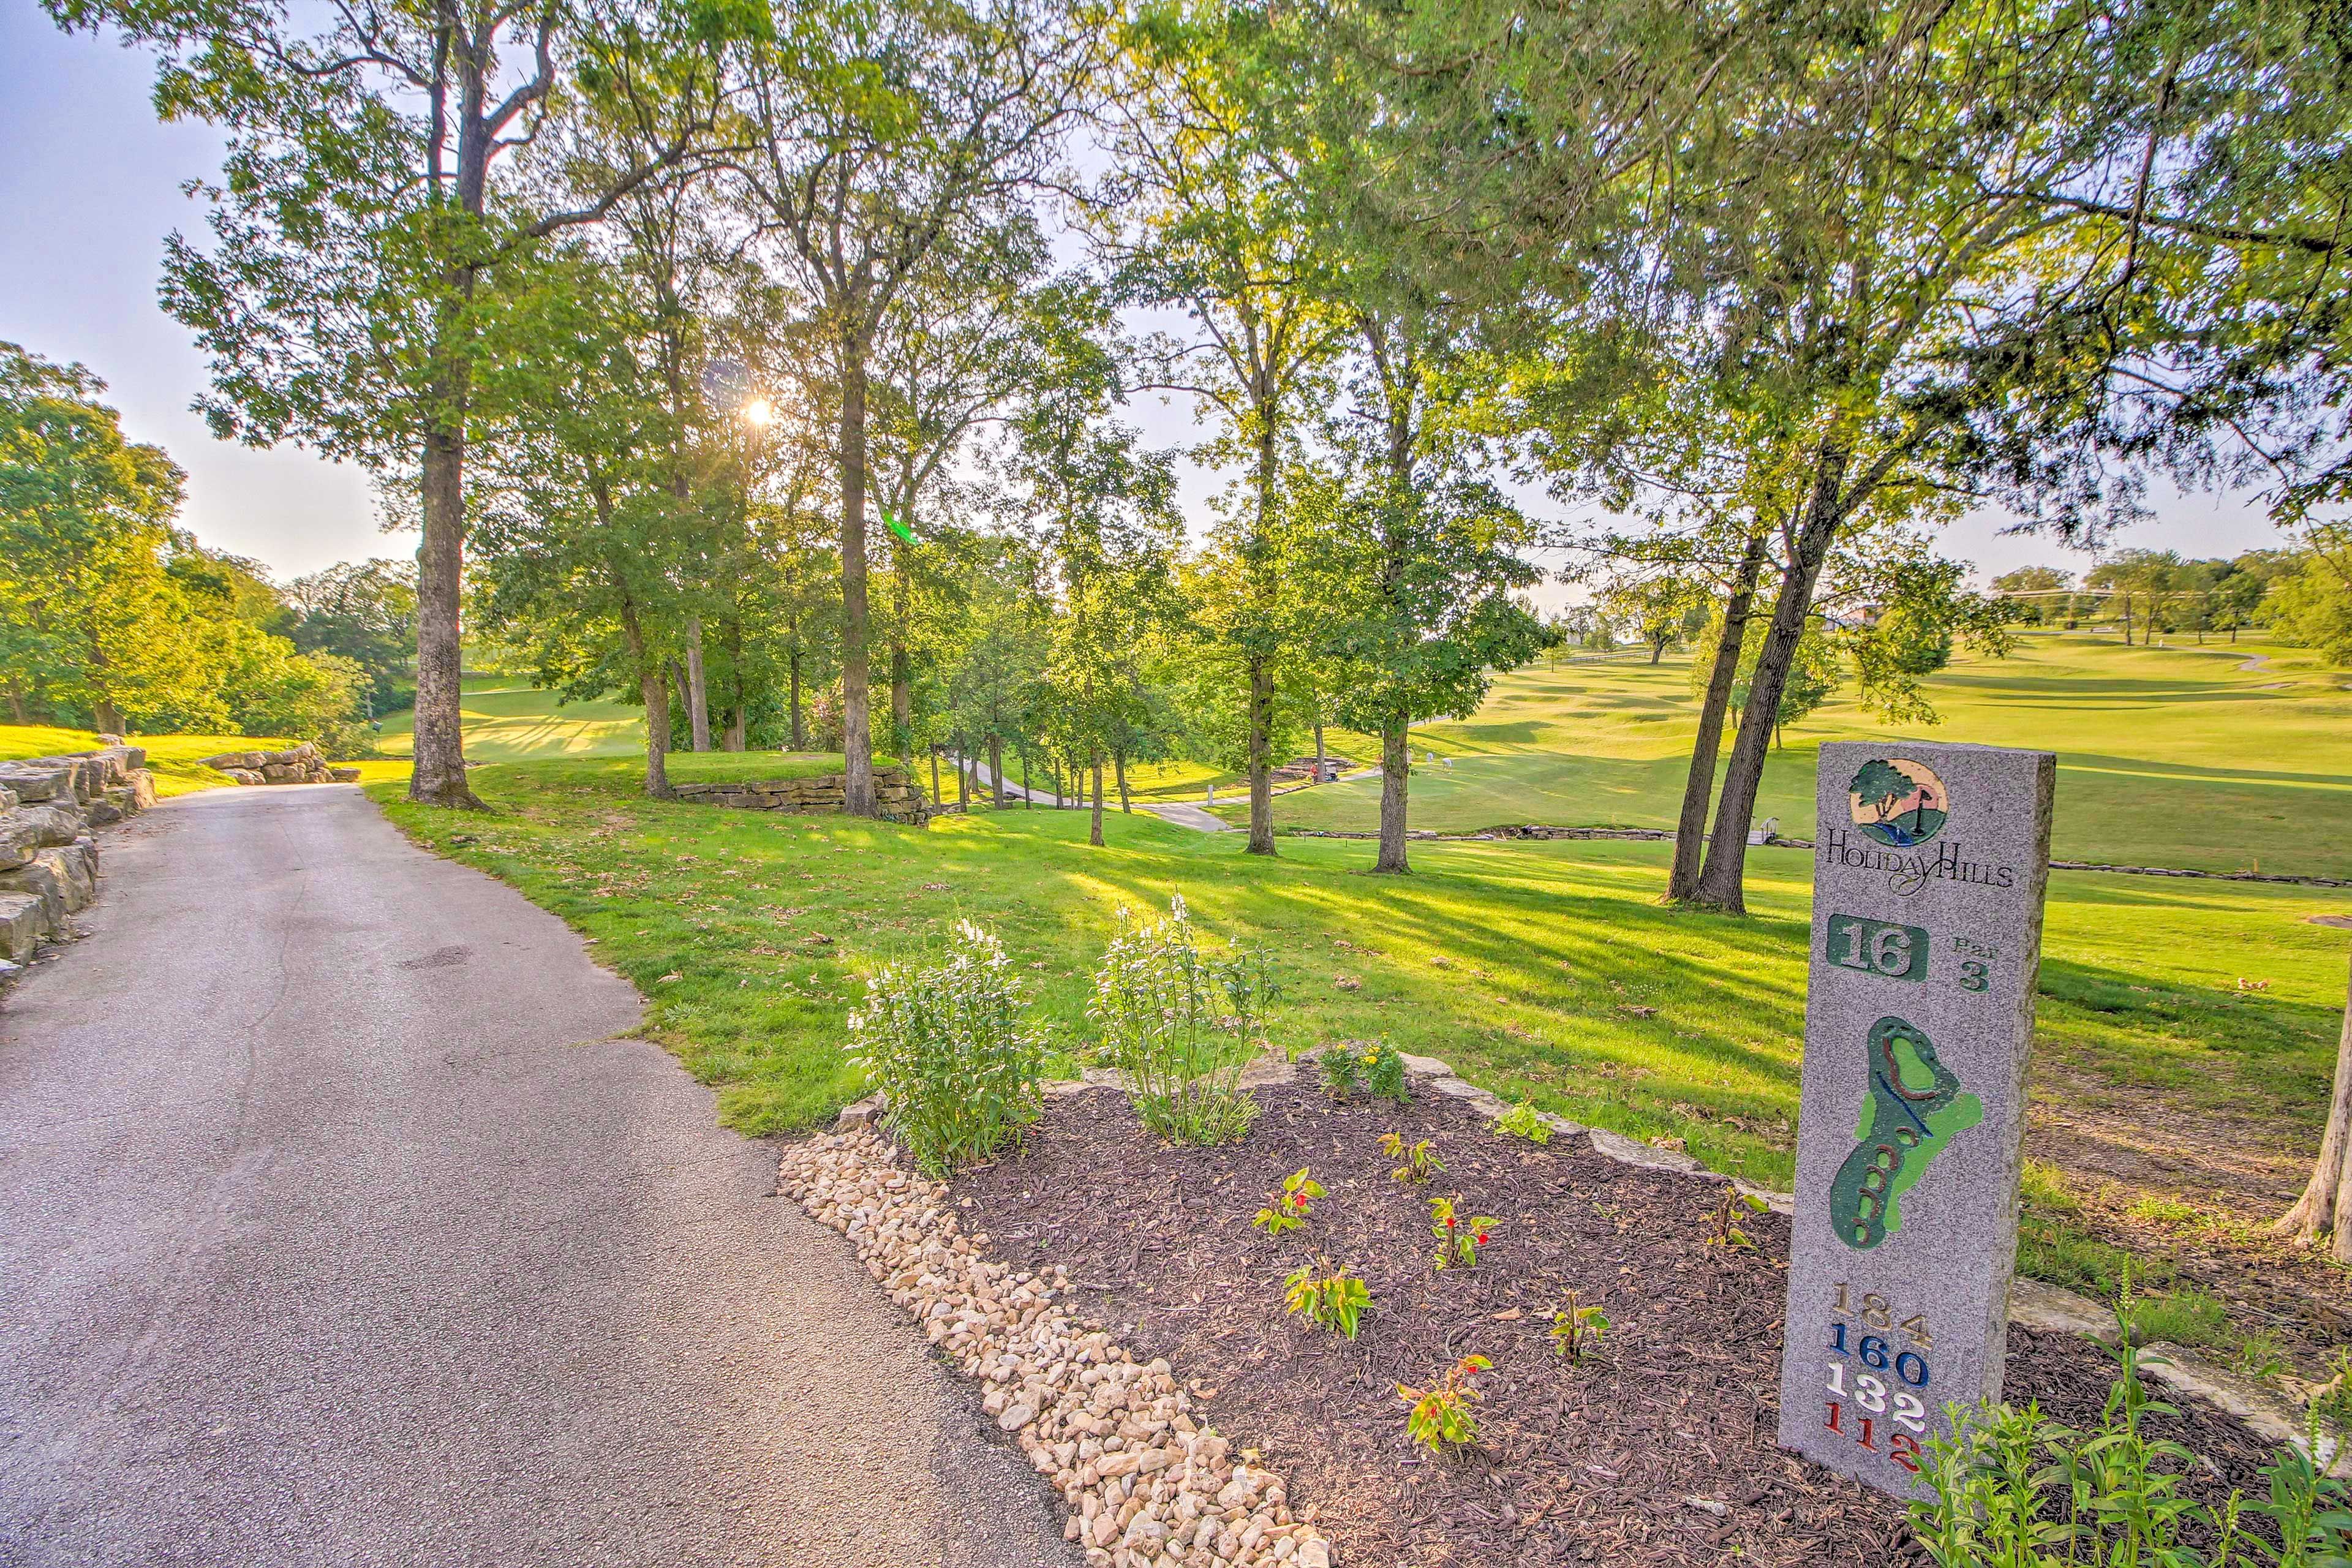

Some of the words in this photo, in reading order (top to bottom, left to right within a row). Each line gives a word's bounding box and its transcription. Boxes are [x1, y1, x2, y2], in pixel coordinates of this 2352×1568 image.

[1936, 841, 2013, 888] HILLS
[1841, 923, 1912, 976] 16
[1953, 937, 2000, 961] Par
[1960, 960, 1989, 993] 3
[1832, 1283, 1932, 1351] 184
[1830, 1323, 1929, 1389] 160
[1826, 1362, 1926, 1432] 132
[1823, 1402, 1921, 1472] 112
